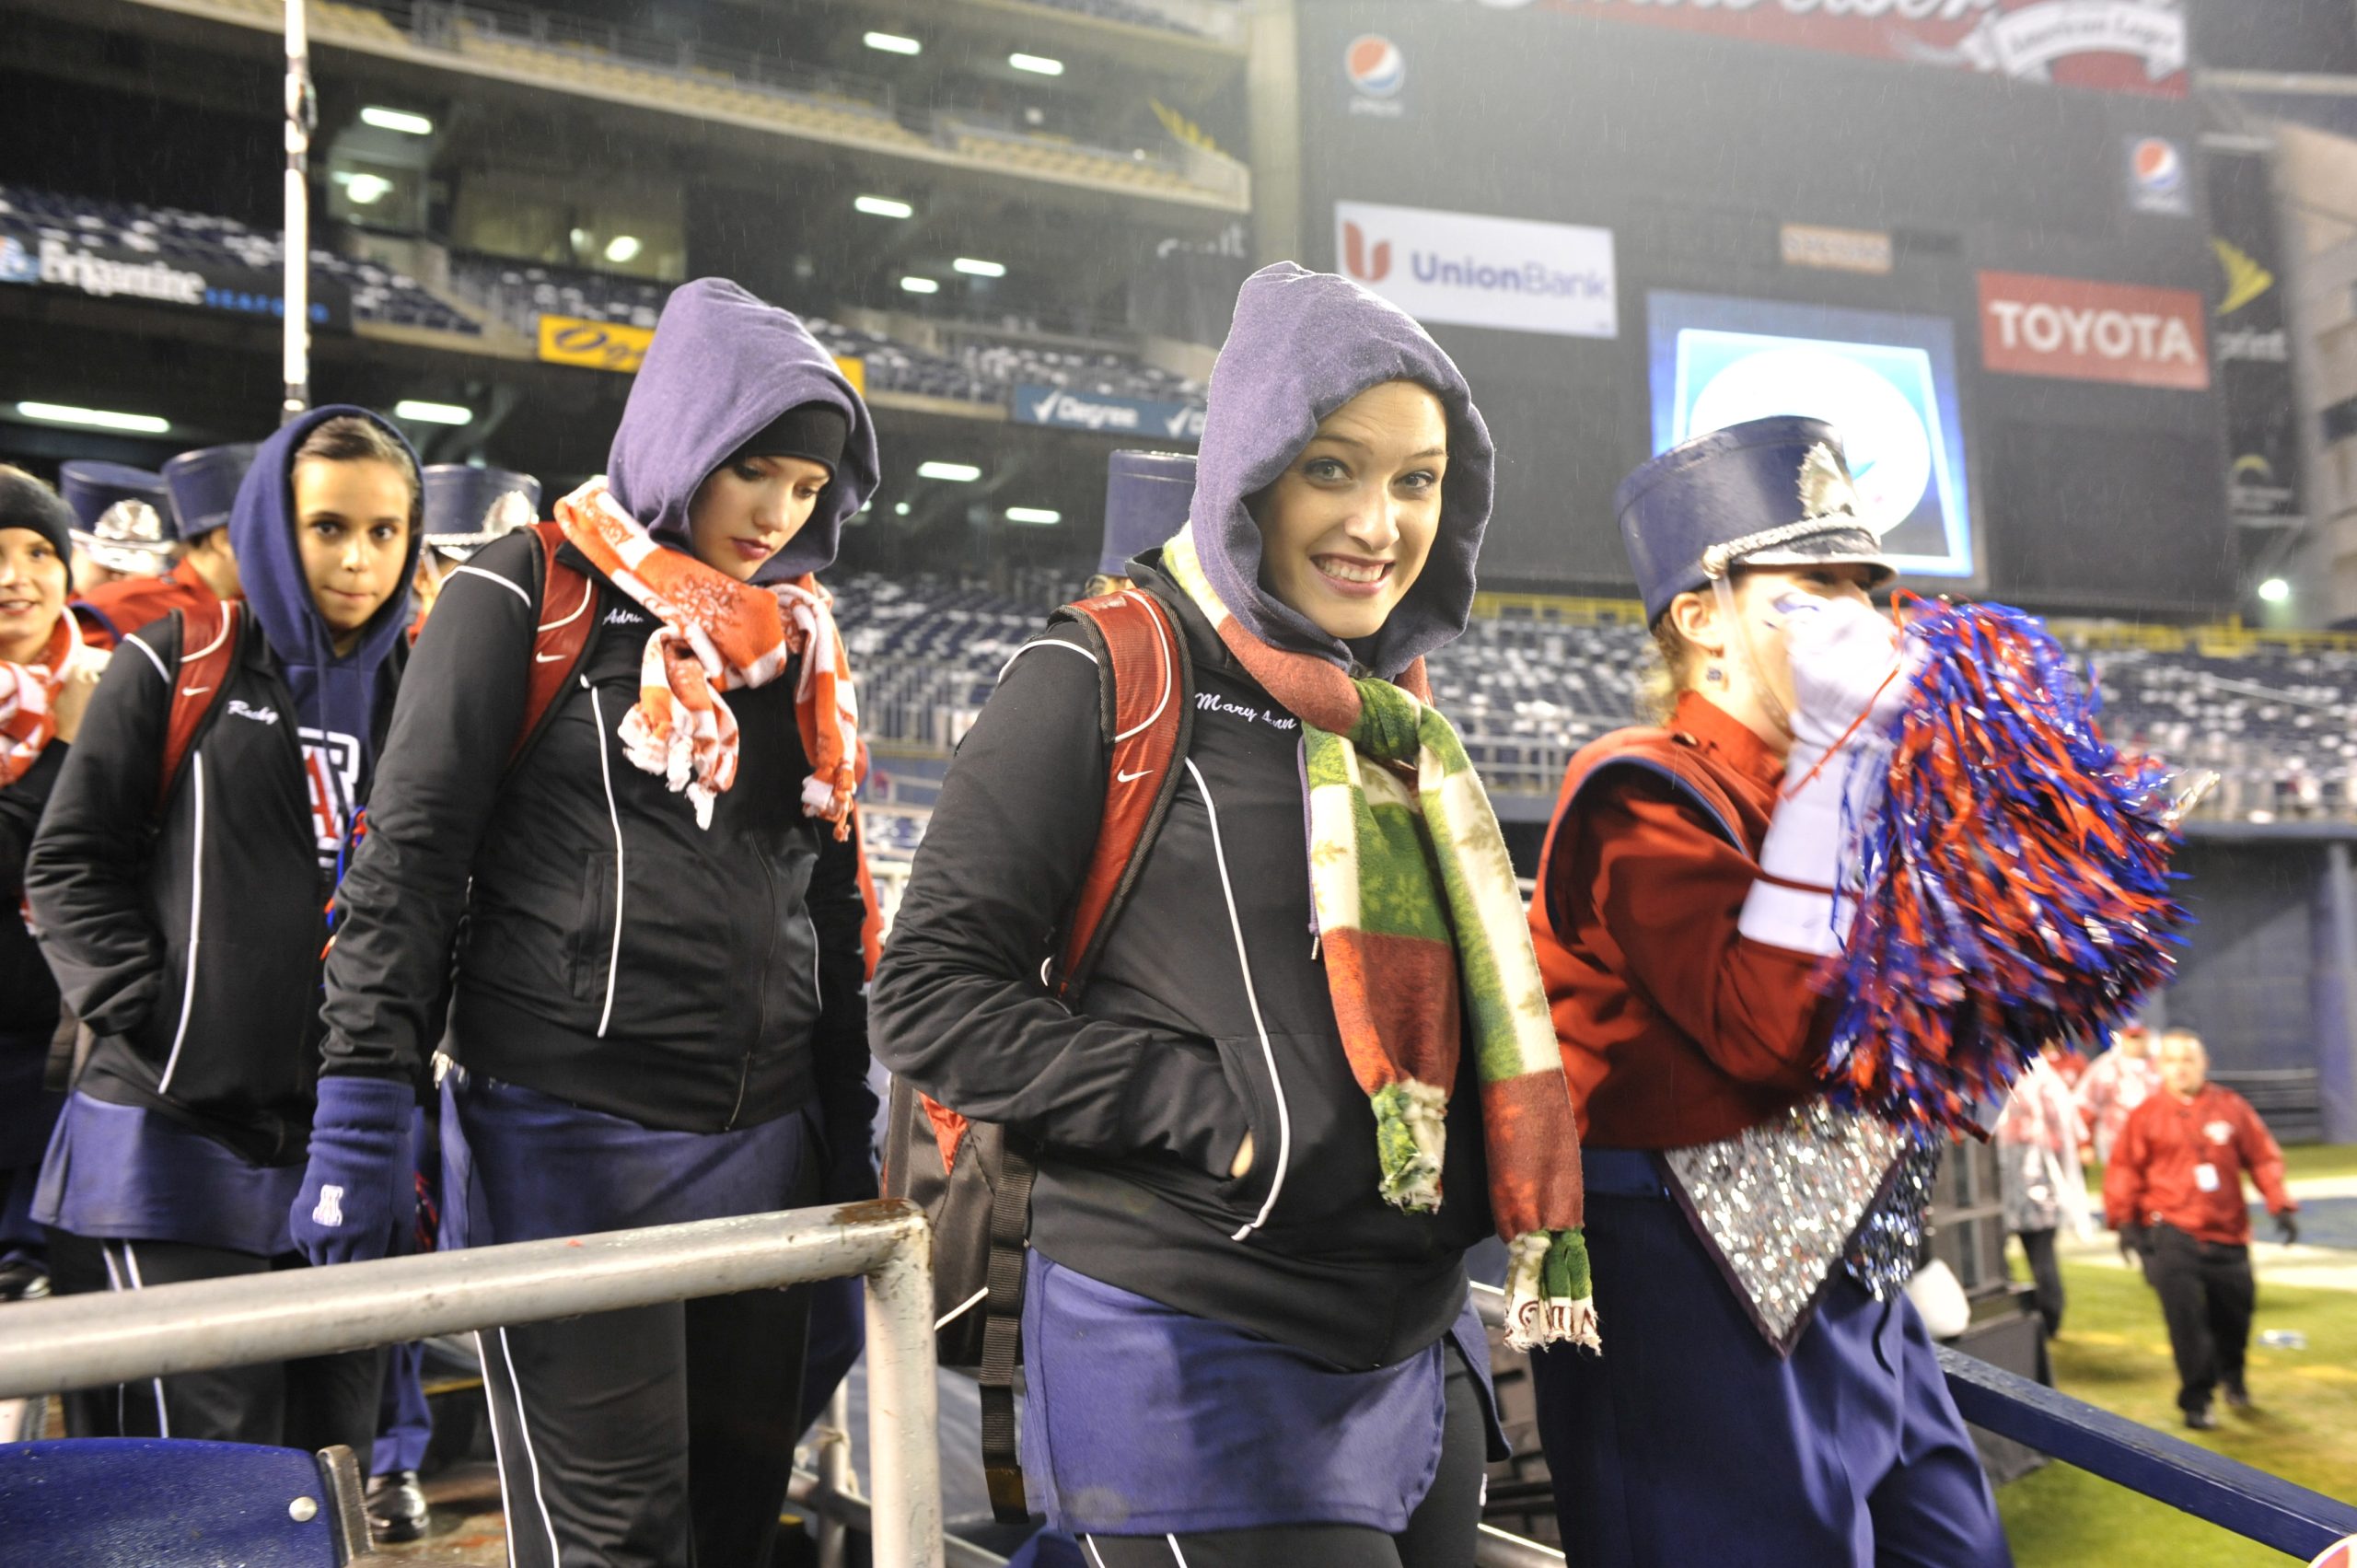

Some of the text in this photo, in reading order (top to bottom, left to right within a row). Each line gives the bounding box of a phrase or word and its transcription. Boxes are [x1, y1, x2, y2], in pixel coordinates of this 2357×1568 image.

[39, 238, 206, 305] Brigantine
[1411, 251, 1606, 296] UnionBank
[1990, 300, 2199, 365] TOYOTA
[1057, 395, 1139, 430] Degree
[1195, 692, 1296, 729] Mary Ann
